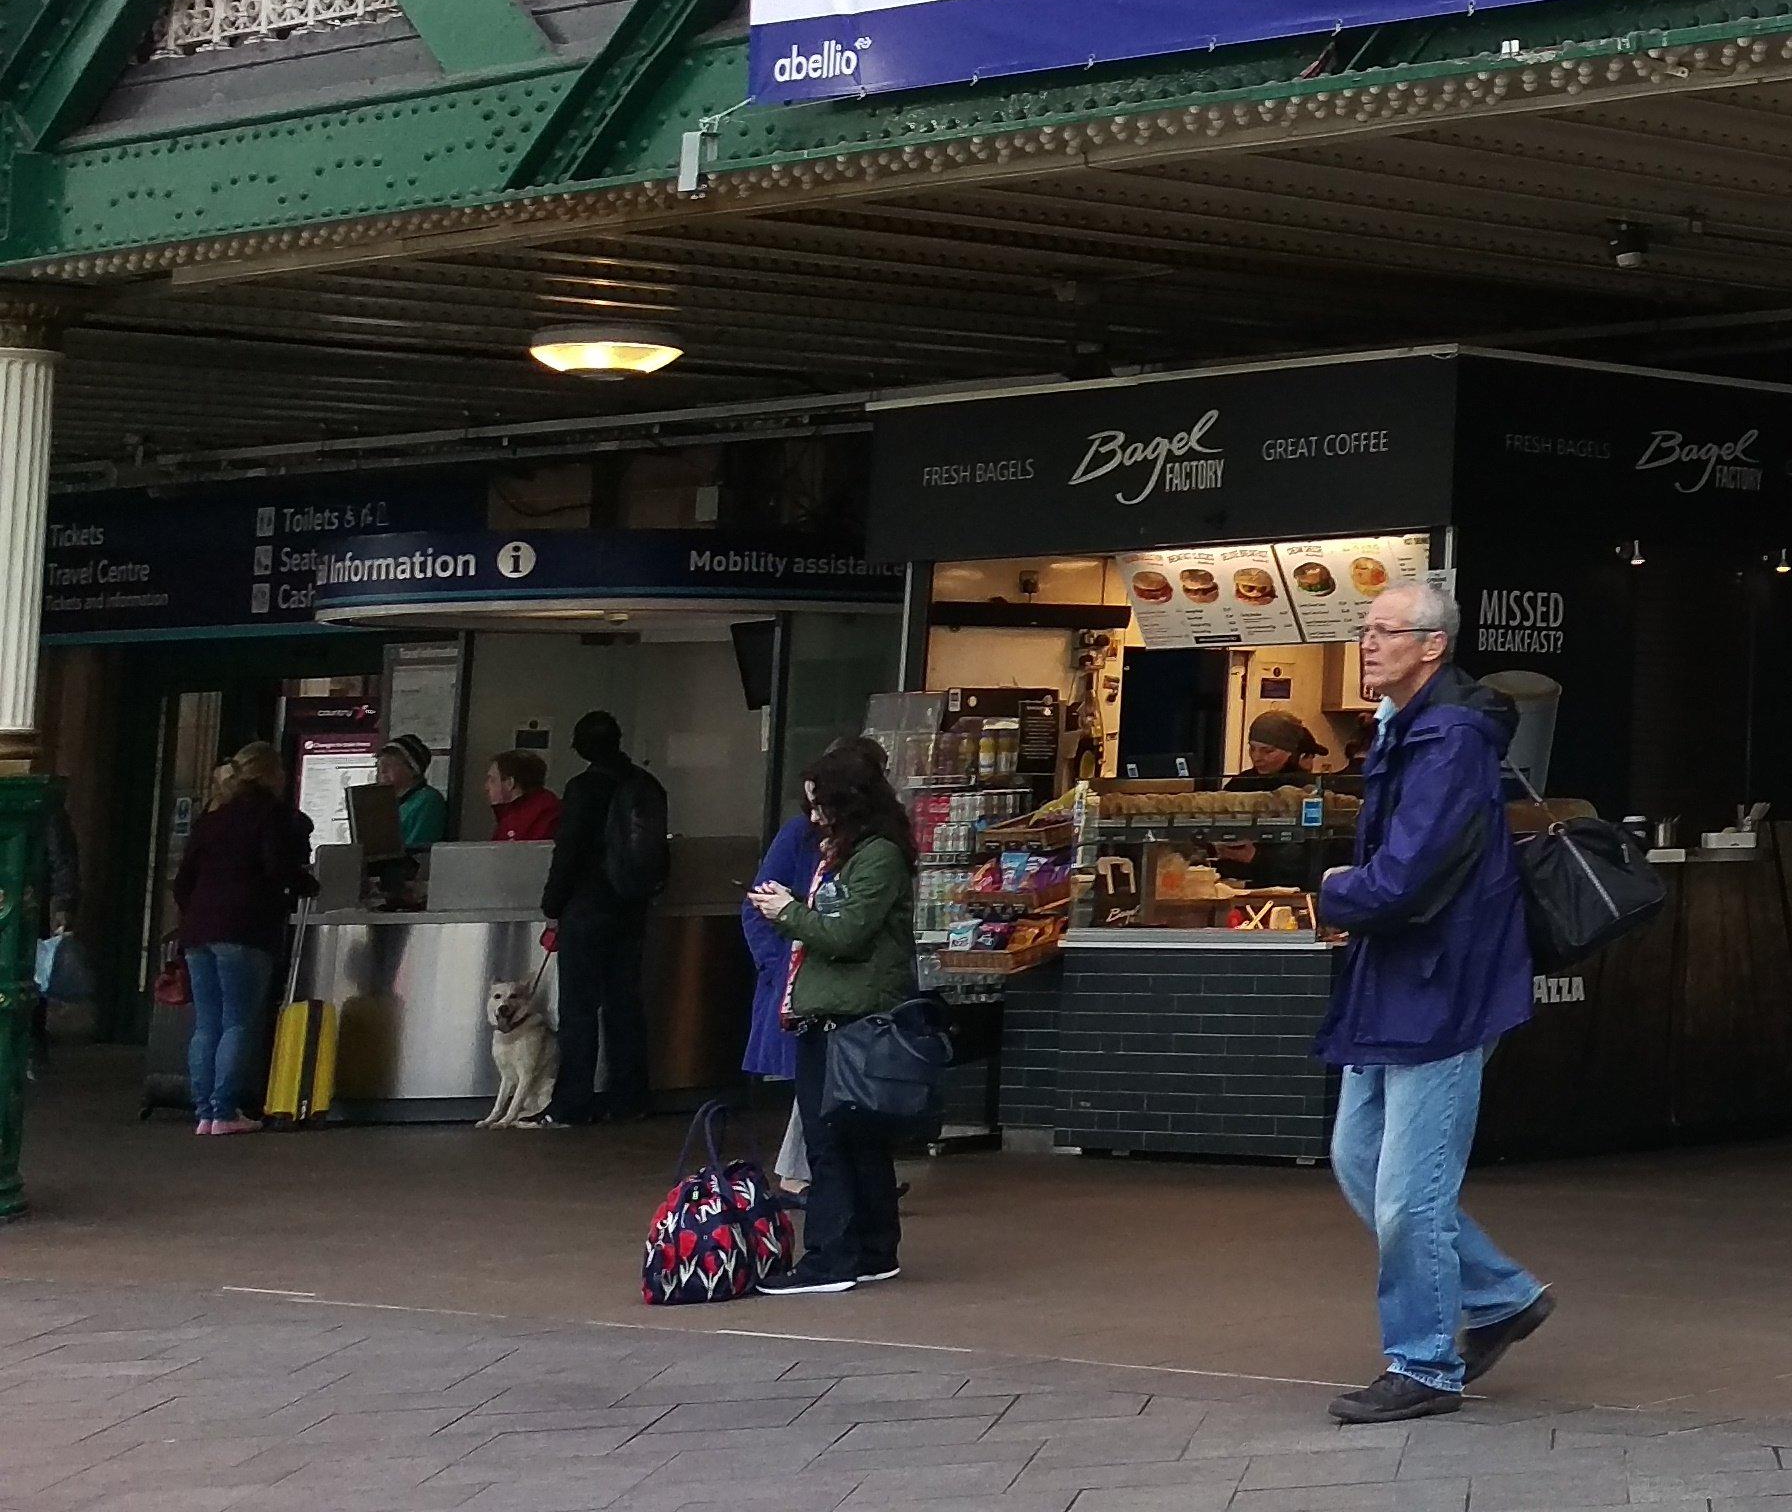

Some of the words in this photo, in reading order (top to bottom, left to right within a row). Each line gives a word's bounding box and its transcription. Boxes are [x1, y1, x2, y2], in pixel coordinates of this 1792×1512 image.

[774, 39, 857, 82] abellio
[1068, 409, 1223, 506] Bagel
[1261, 433, 1319, 462] GREAT
[1324, 431, 1389, 456] COFFEE
[1505, 433, 1552, 456] FRESH
[1557, 437, 1611, 459] BAGELS
[923, 465, 970, 487] FRESH
[976, 458, 1034, 483] BAGELS
[1634, 429, 1761, 493] Bagel
[1165, 459, 1225, 493] FACTORY
[1716, 466, 1763, 491] FACTORY
[283, 506, 339, 532] Toilets
[50, 523, 104, 547] Tickets
[47, 560, 93, 585] Travel
[97, 560, 150, 583] Centre
[280, 547, 318, 572] Seat
[329, 547, 477, 583] Information
[690, 550, 787, 578] Mobility
[1480, 589, 1564, 627] MISSED
[1478, 628, 1564, 653] BREAKFAST?
